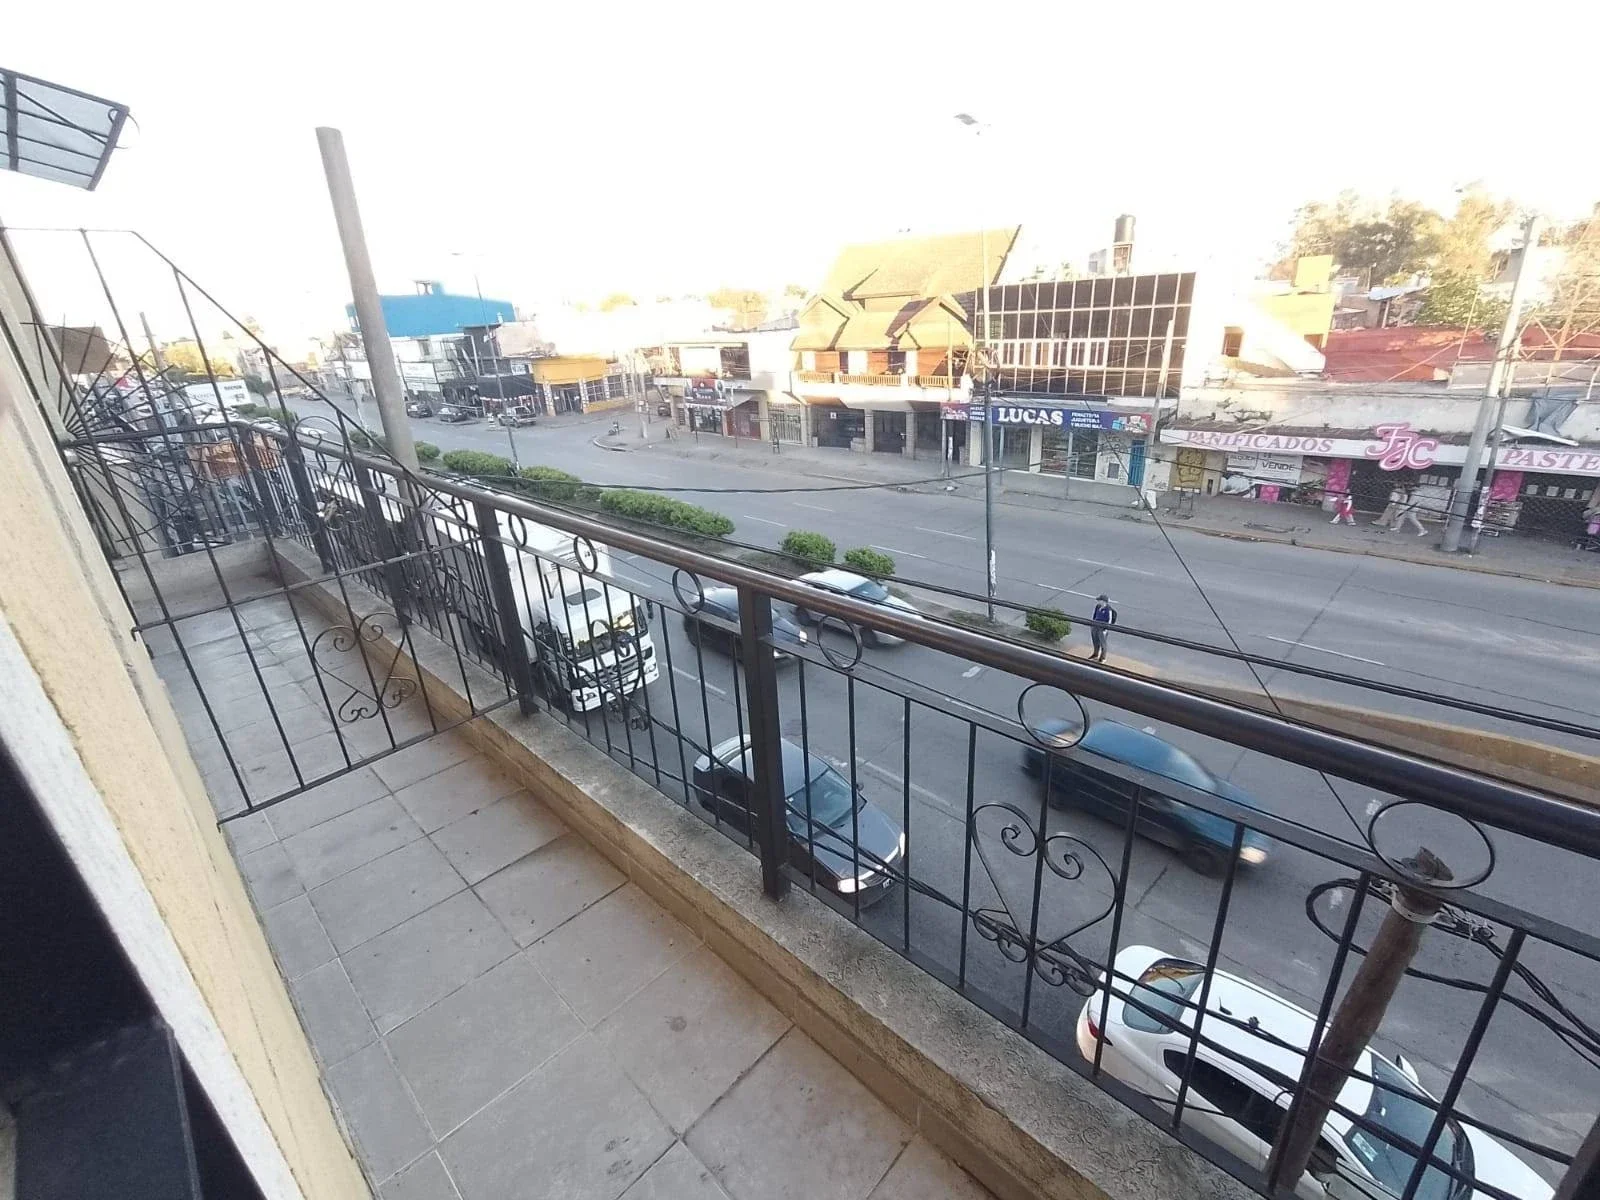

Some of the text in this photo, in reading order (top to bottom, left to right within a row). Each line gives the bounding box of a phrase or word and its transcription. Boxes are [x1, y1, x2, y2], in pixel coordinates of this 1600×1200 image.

[998, 407, 1064, 426] LUCAS
[1187, 431, 1334, 453] PANIFICADOS
[1262, 461, 1294, 471] VENDE
